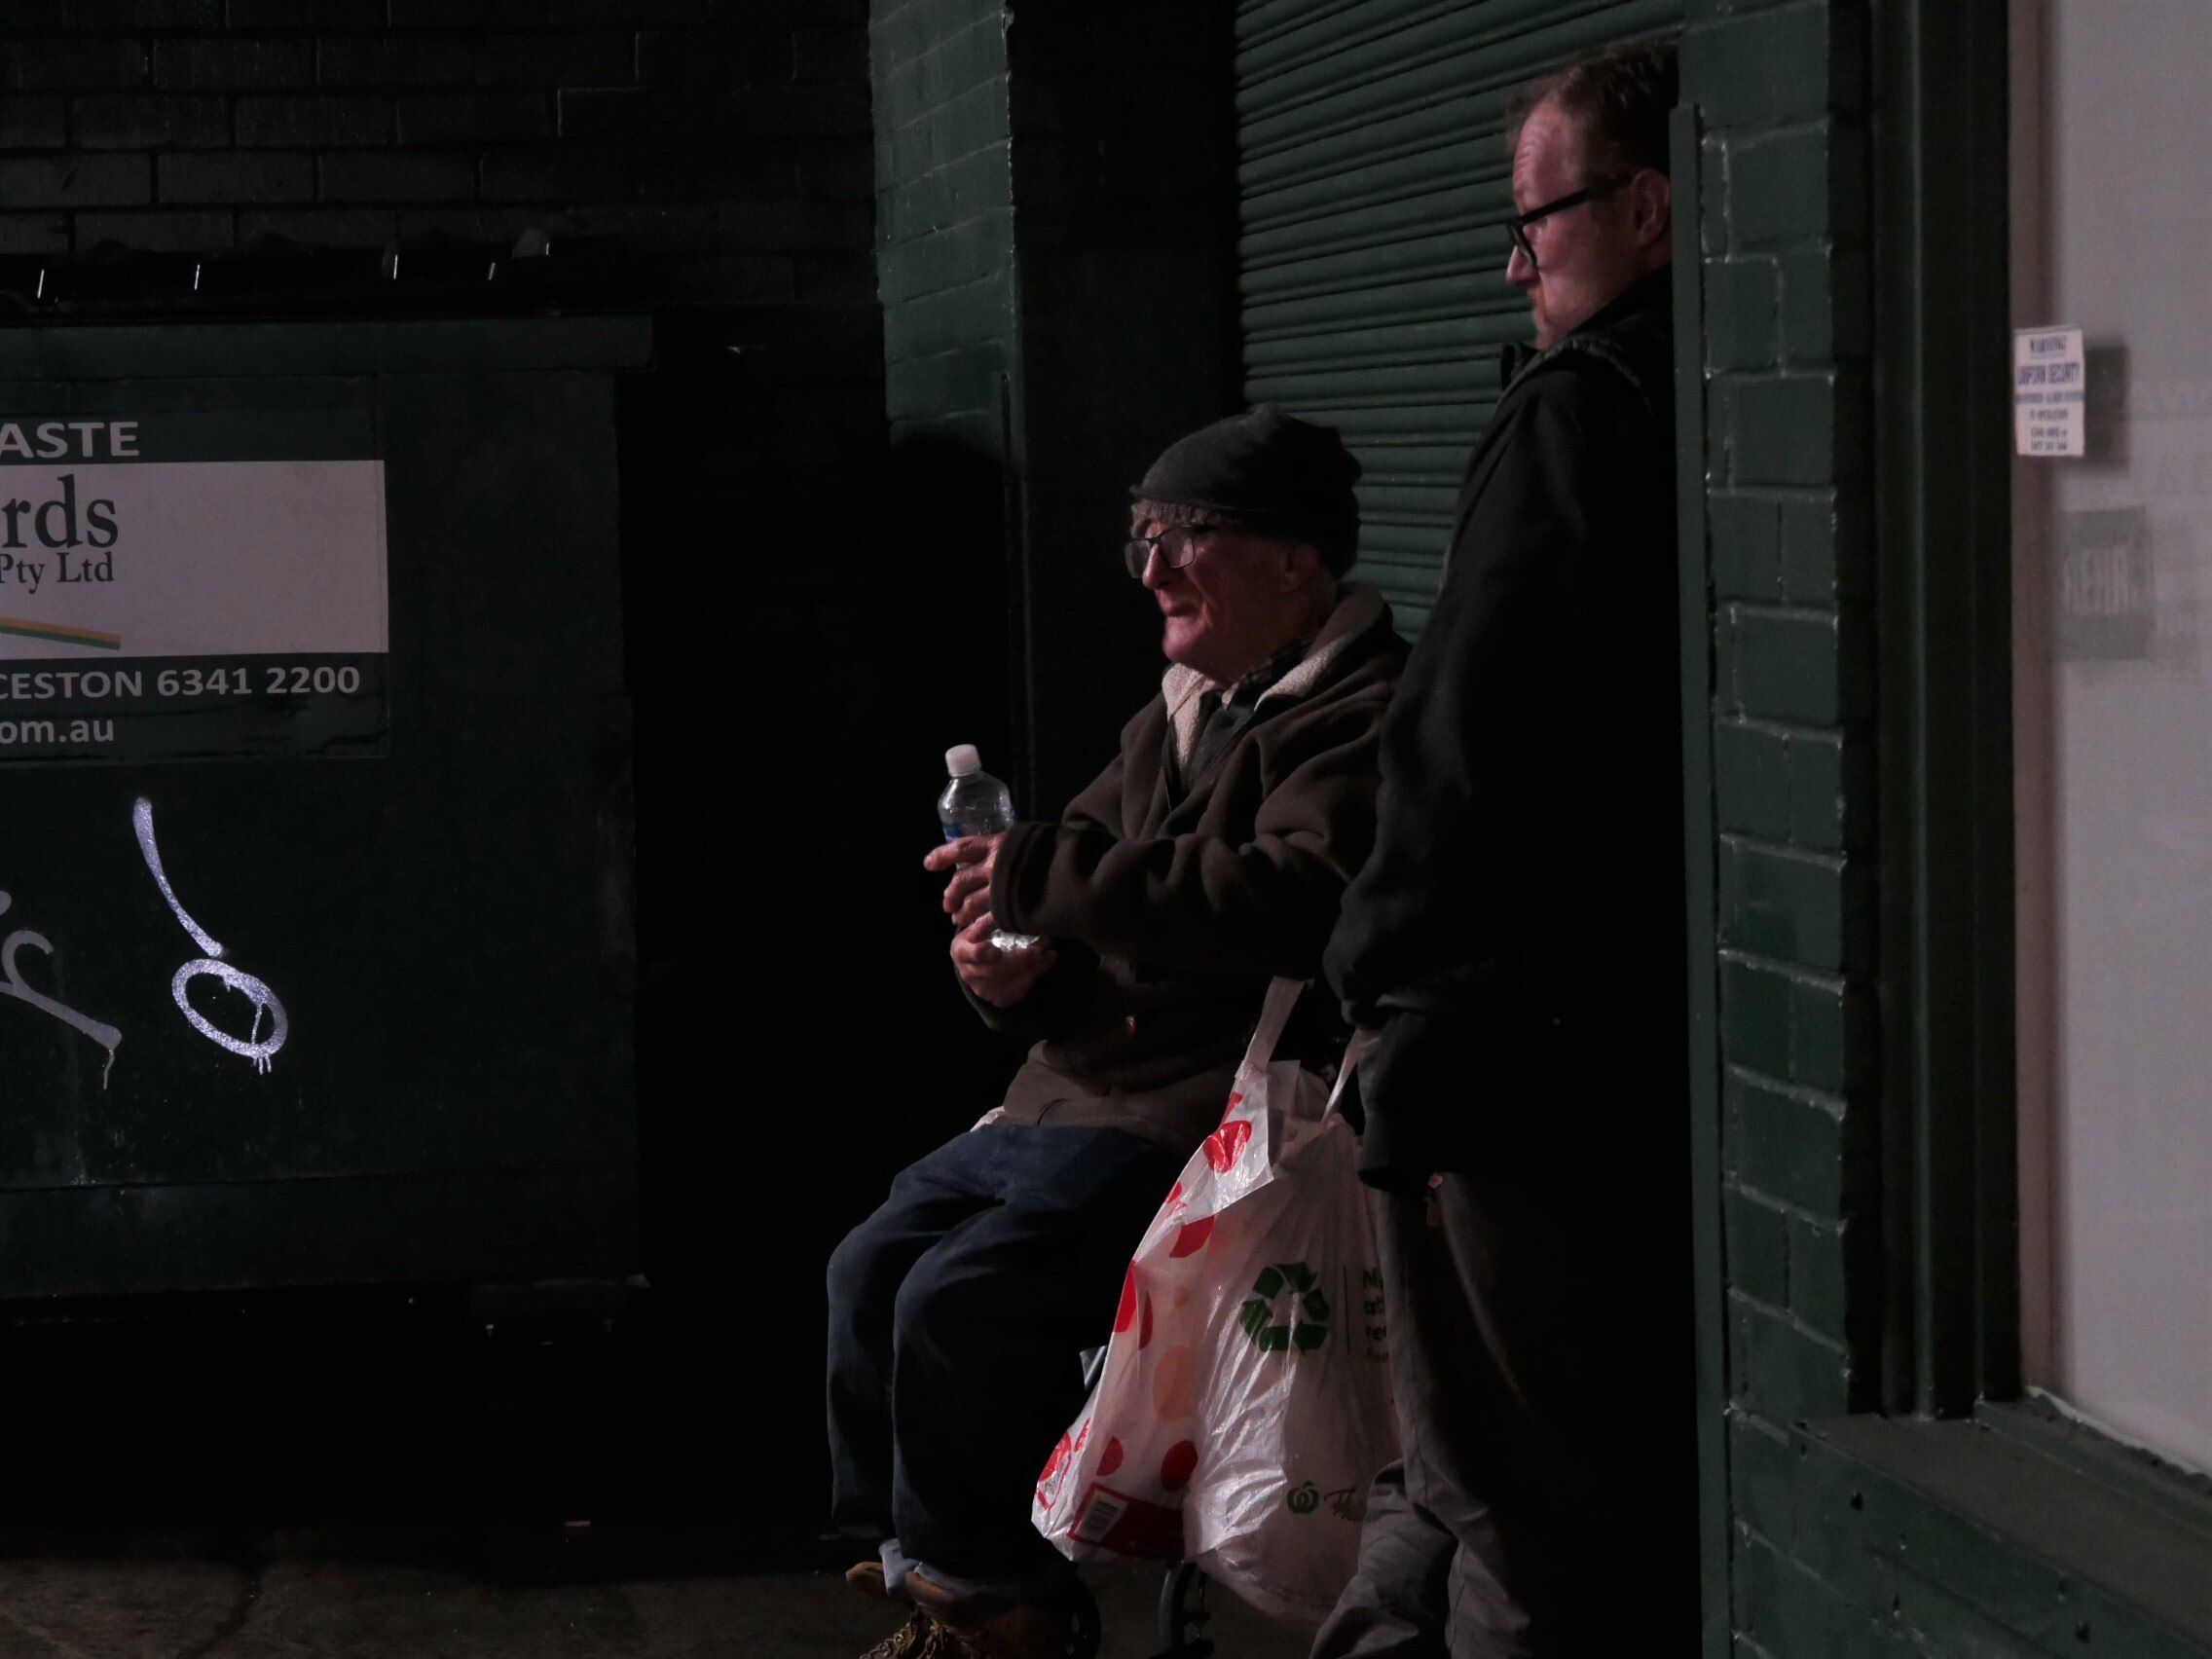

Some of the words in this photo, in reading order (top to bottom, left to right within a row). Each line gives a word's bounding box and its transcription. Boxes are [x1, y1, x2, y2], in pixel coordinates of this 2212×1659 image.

[0, 422, 140, 459] ASTE
[1, 473, 119, 548] rds
[0, 553, 46, 594] Pty
[56, 551, 115, 582] Ltd
[157, 667, 252, 696] 6341
[266, 665, 361, 694] 2200
[0, 719, 115, 744] om.au
